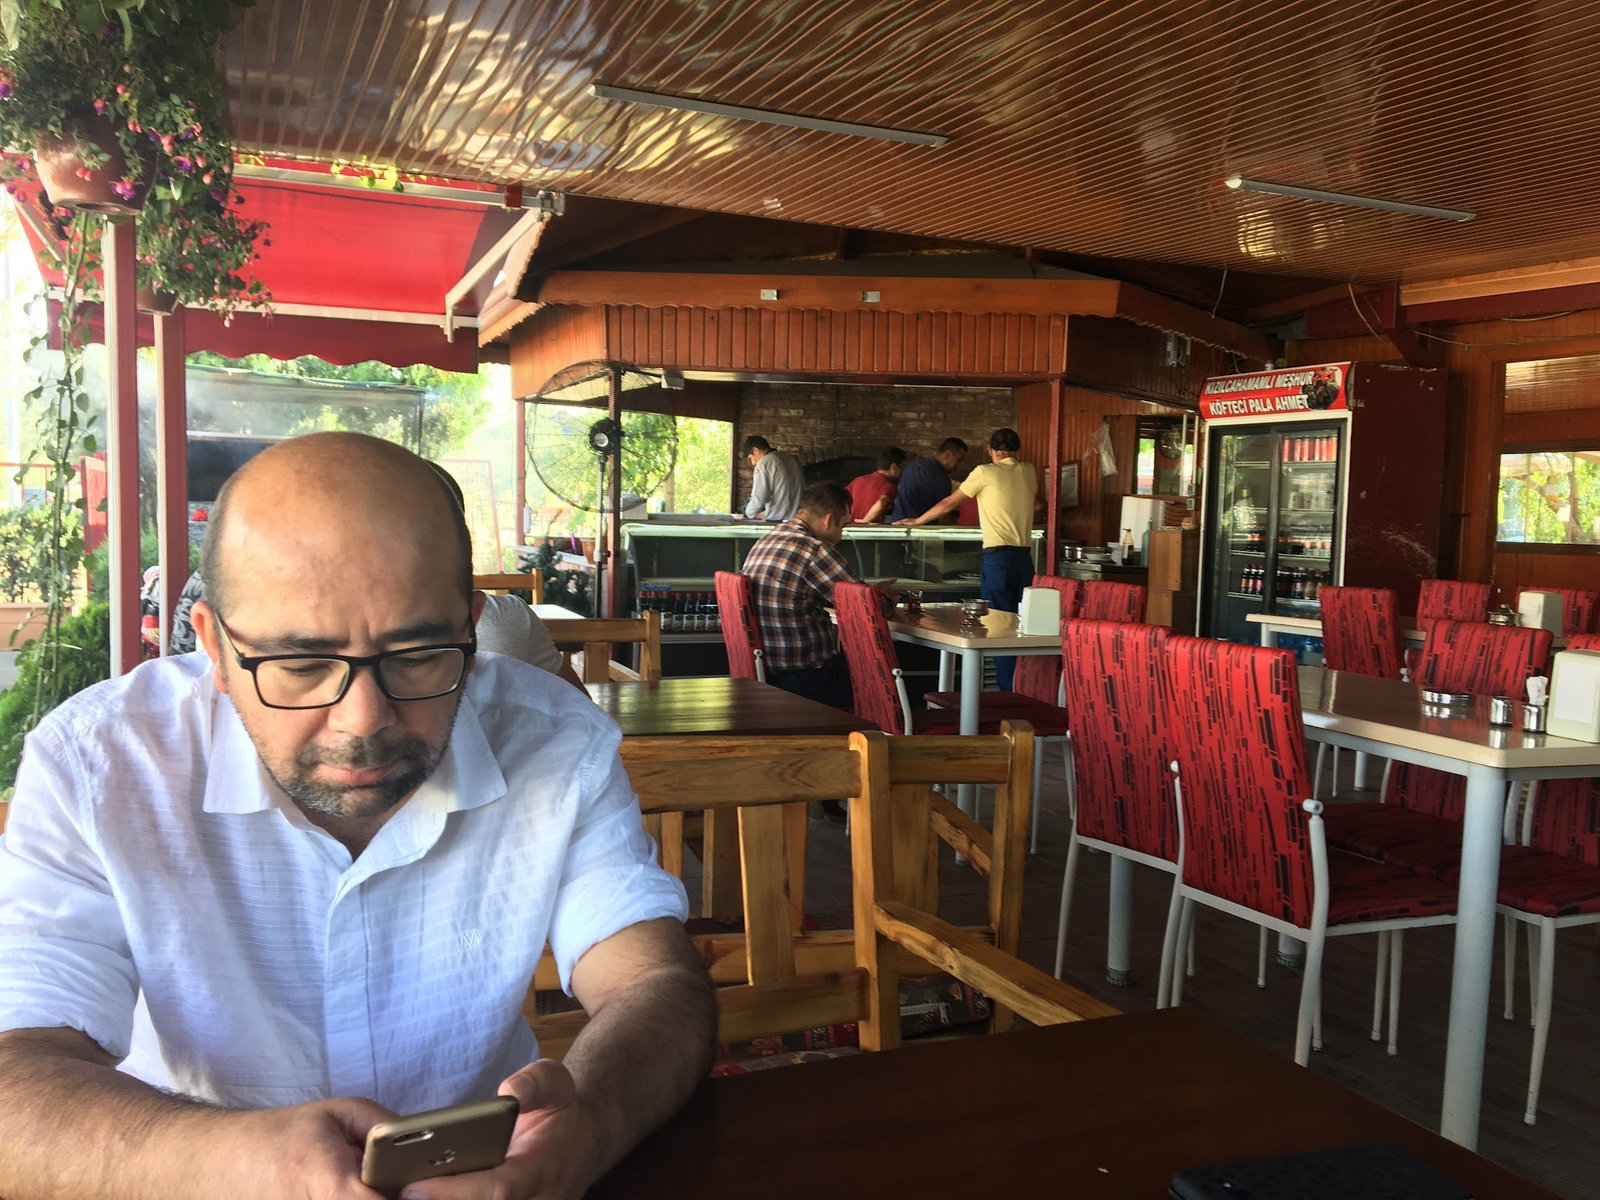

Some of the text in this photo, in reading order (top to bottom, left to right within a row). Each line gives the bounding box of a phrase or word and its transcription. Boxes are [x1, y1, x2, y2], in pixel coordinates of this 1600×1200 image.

[1276, 371, 1315, 390] MEŞHUR
[1209, 395, 1309, 415] KÖFTECİ PALA AHMET
